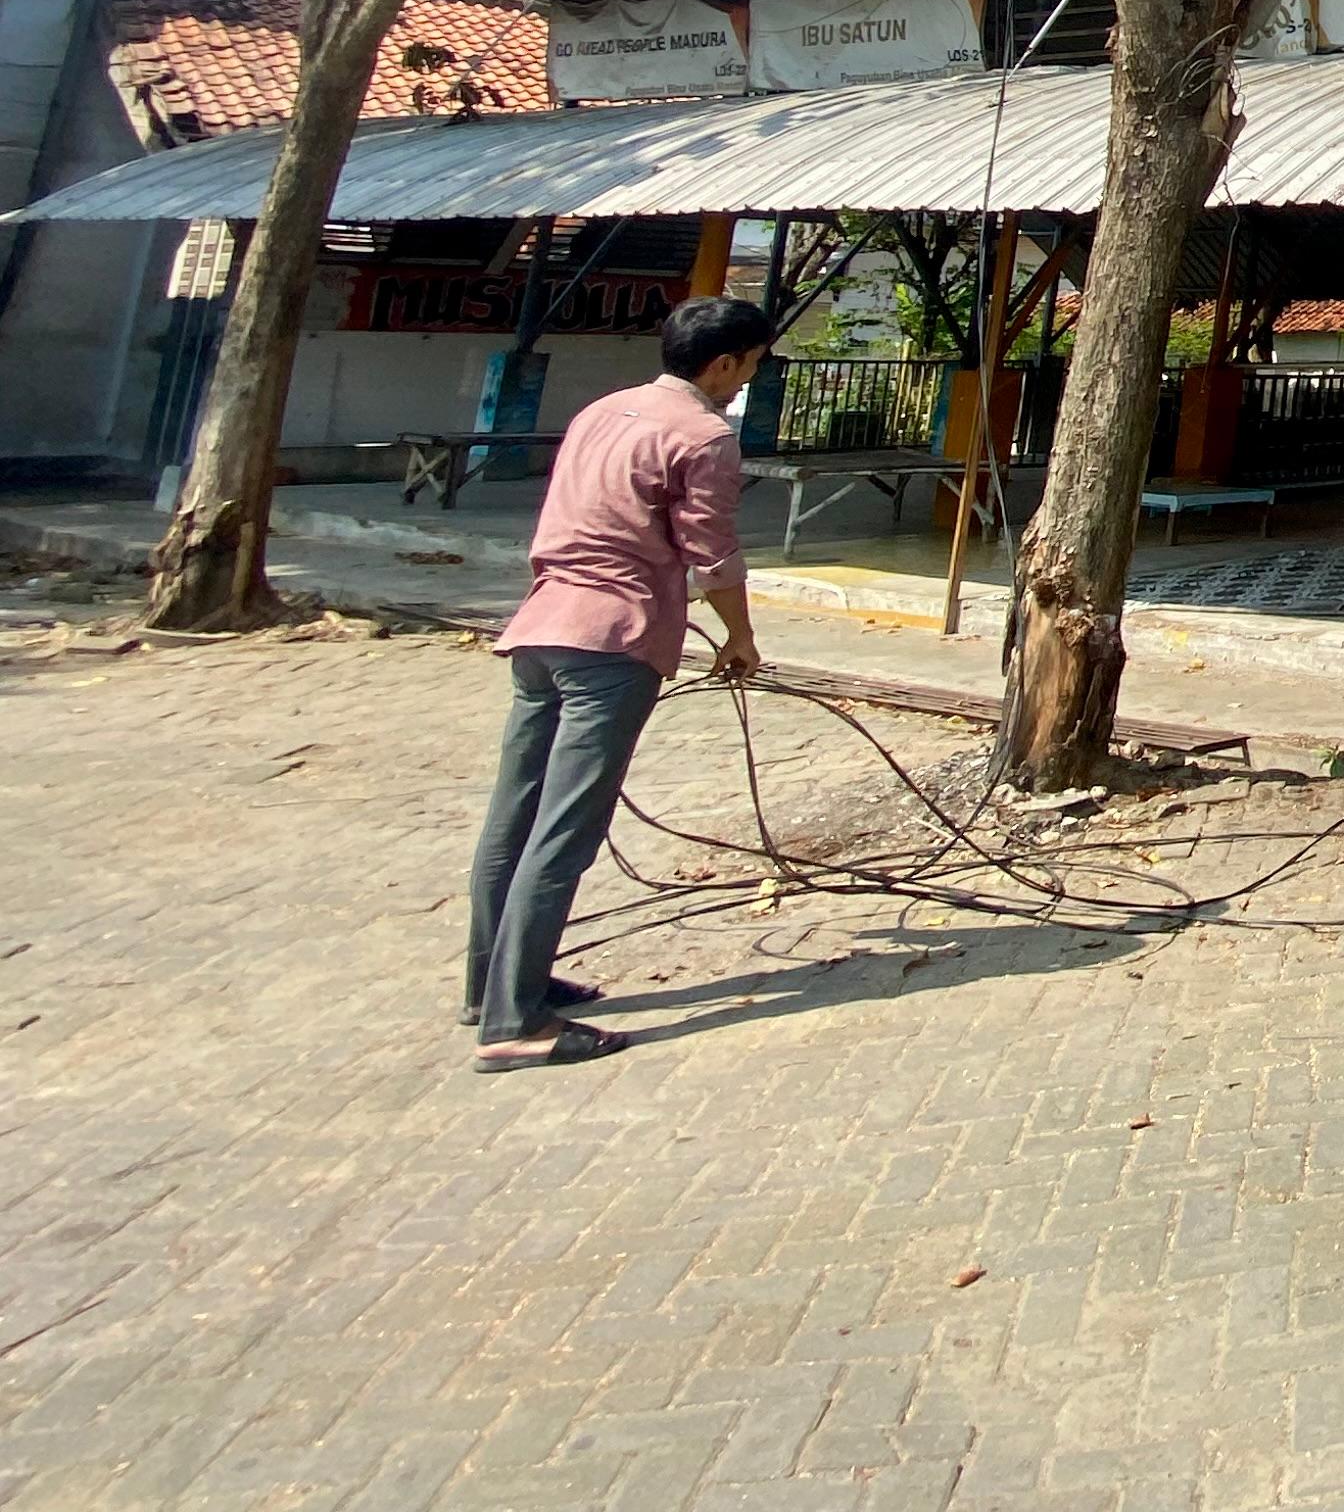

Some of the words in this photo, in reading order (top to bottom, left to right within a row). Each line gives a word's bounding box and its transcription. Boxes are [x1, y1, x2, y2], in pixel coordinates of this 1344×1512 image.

[670, 30, 728, 51] MADURA
[802, 23, 834, 47] IBU
[839, 19, 907, 45] SATUN
[368, 274, 674, 334] MUSOLLA
